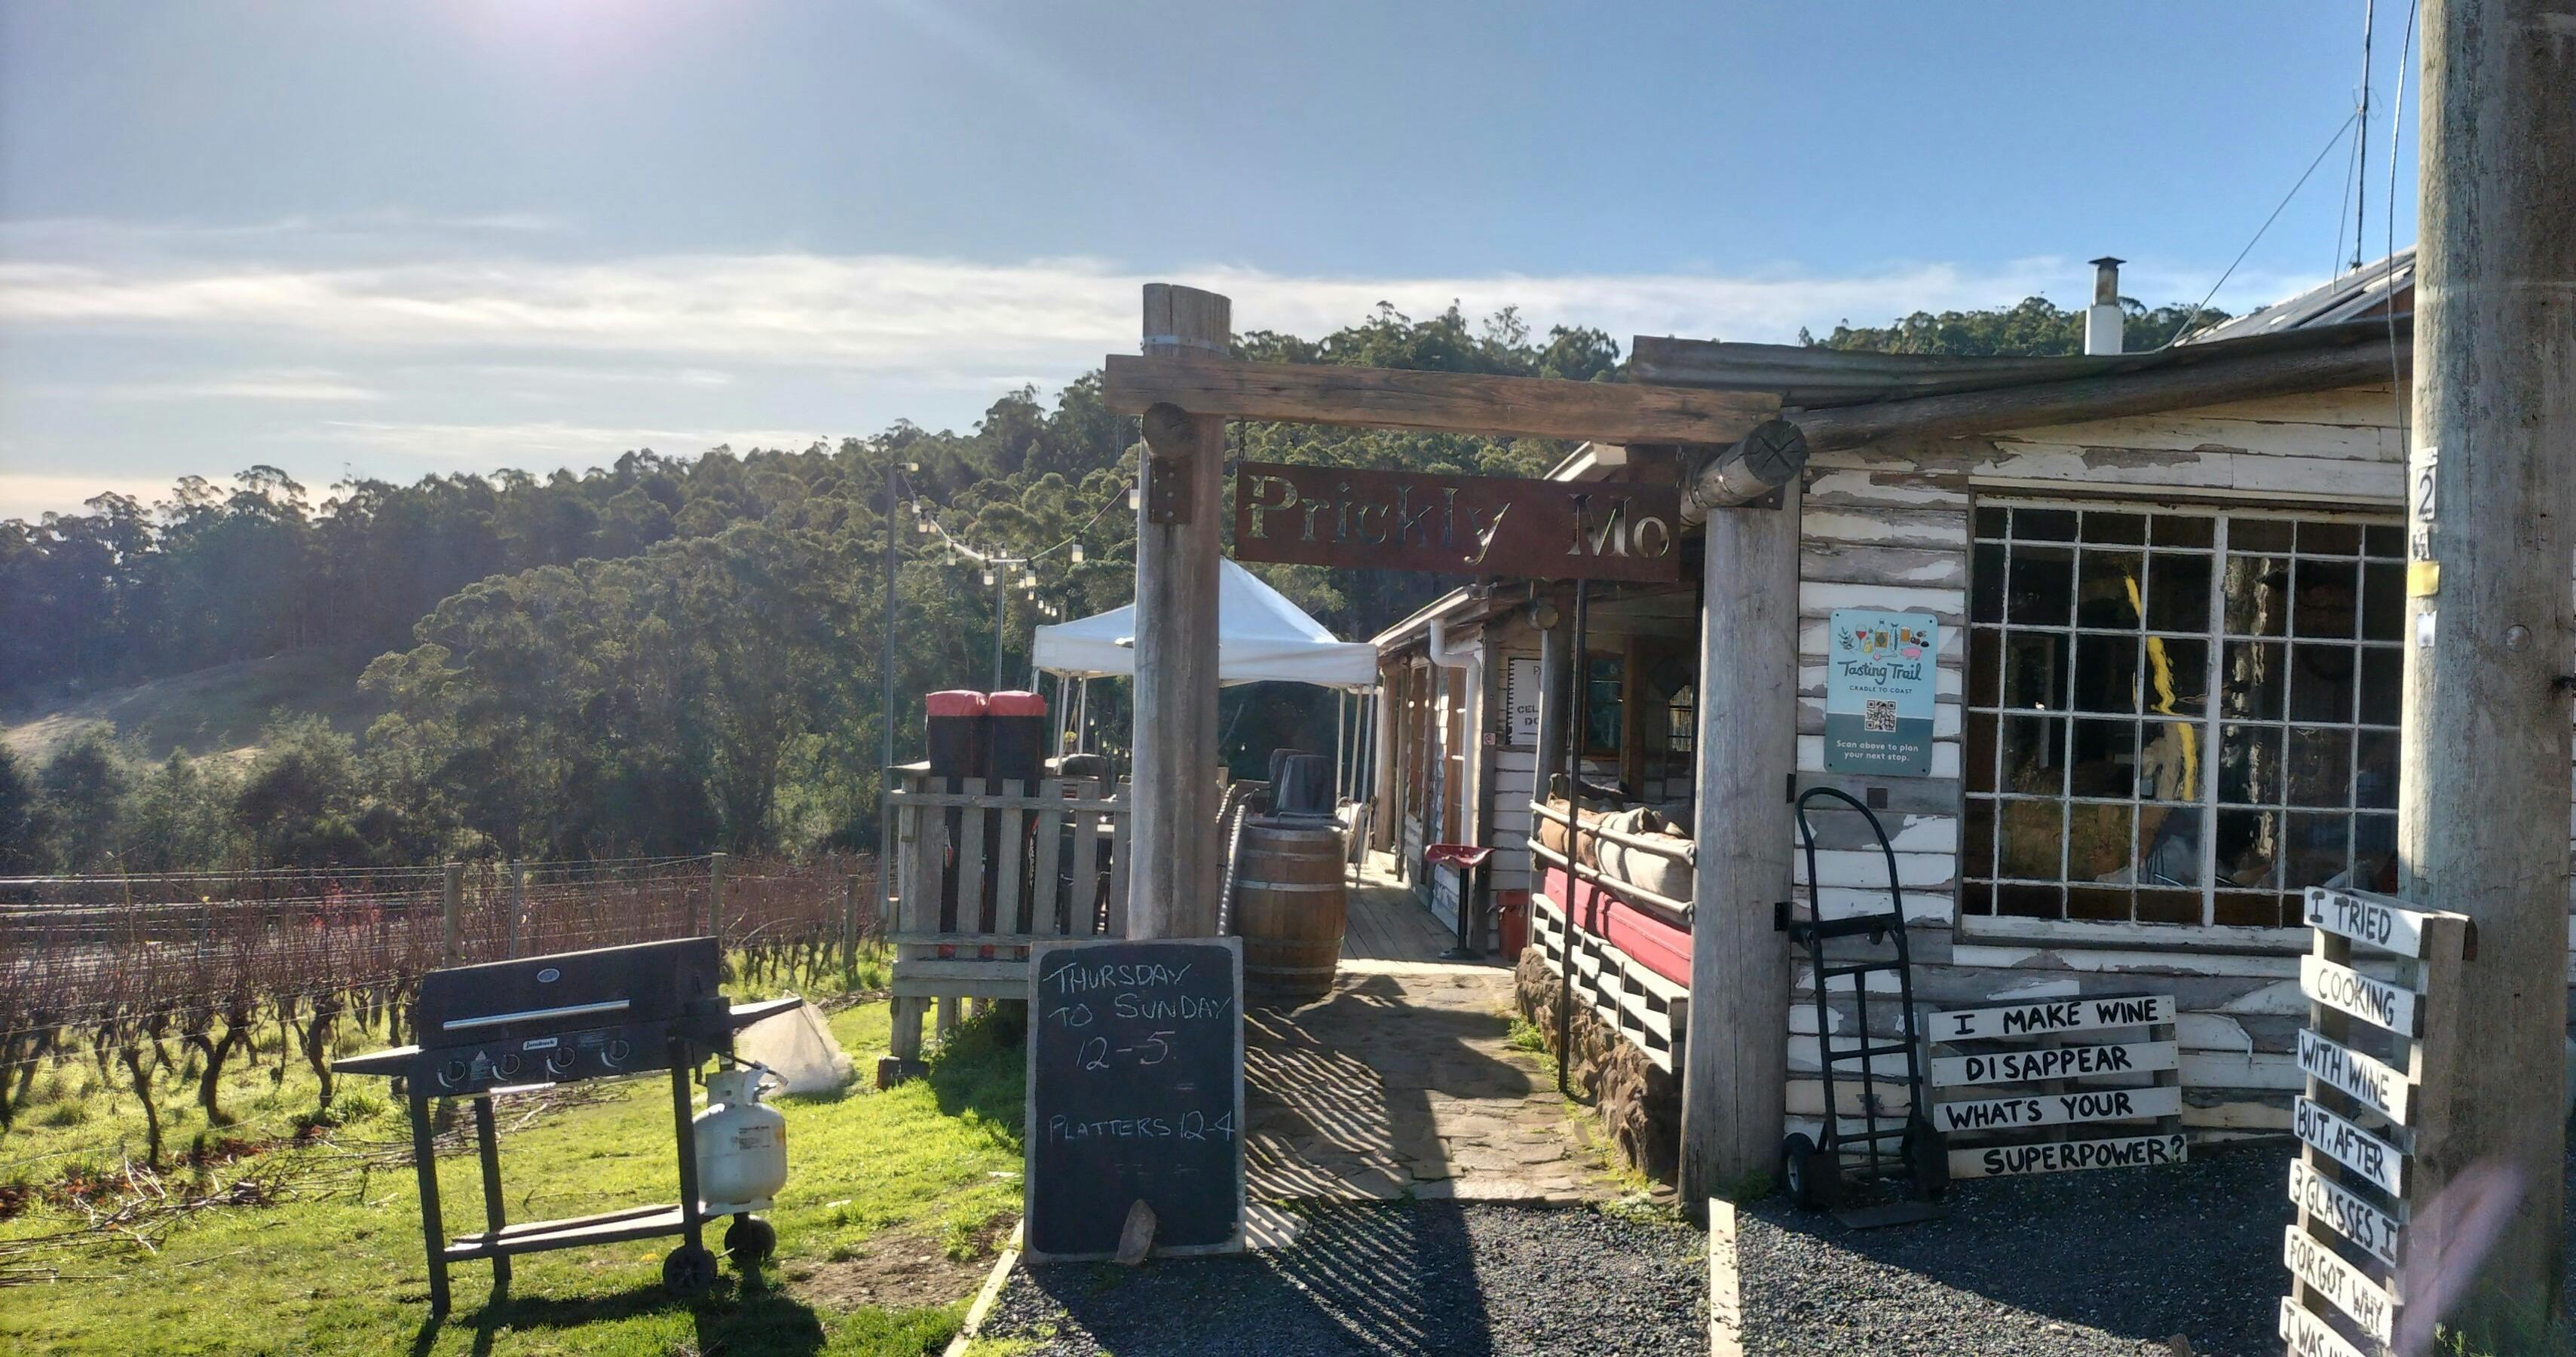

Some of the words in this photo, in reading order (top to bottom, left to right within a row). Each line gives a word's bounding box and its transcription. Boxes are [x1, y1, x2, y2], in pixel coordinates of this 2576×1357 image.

[1245, 473, 1511, 566] Prickly
[1567, 492, 1671, 559] Mo
[1837, 660, 1887, 685] Tasting
[1887, 663, 1922, 681] Trail
[1836, 740, 1858, 749] Scan
[1860, 740, 1885, 750] above
[1888, 743, 1898, 751] to
[1900, 743, 1919, 753] plan
[1844, 750, 1864, 760] your
[1866, 752, 1885, 760] next
[1888, 752, 1910, 762] stop.
[2309, 890, 2326, 924] I
[2333, 896, 2392, 945] TRIED
[1042, 962, 1191, 995] THURSDAY
[2317, 968, 2396, 1027] COOKING
[1048, 1003, 1093, 1028] TO
[1114, 993, 1231, 1020] SUNDAY
[1953, 1013, 1975, 1035] I
[2003, 1001, 2082, 1035] MAKE
[2096, 999, 2159, 1025] WINE
[1965, 1046, 2132, 1081] DISAPPEAR
[2301, 1035, 2342, 1086] WITH
[2348, 1057, 2390, 1113] WINE
[1049, 1113, 1172, 1146] PLATTERS
[1946, 1099, 2043, 1129] WHAT'S
[2060, 1092, 2133, 1121] YOUR
[1983, 1134, 2185, 1175] SUPERPOWER?
[2298, 1098, 2331, 1151] BUT,
[2334, 1122, 2385, 1184] AFTER
[2293, 1163, 2303, 1202] 3
[2306, 1175, 2375, 1249] GLASSES
[2379, 1218, 2397, 1263] I
[2290, 1233, 2346, 1303] FORGOT
[2351, 1279, 2385, 1334] WHY
[2283, 1303, 2295, 1343] I
[2299, 1315, 2325, 1357] WAS
